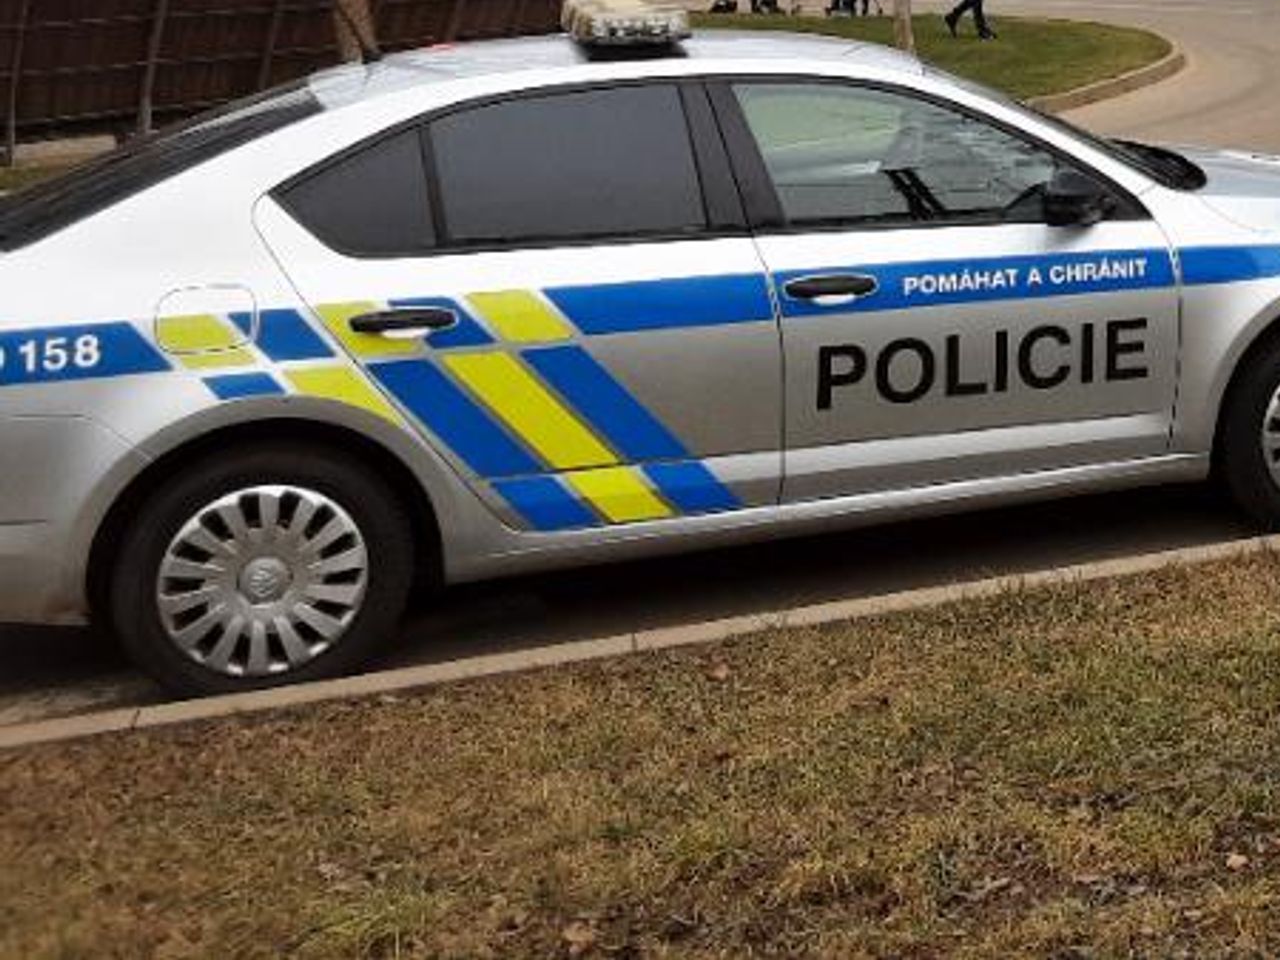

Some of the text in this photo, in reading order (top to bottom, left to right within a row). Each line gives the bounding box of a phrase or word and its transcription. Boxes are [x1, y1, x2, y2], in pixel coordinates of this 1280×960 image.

[903, 258, 1148, 296] POMÁHAT A CHRÁNIT
[18, 333, 101, 374] 158
[815, 317, 1149, 411] POLICIE
